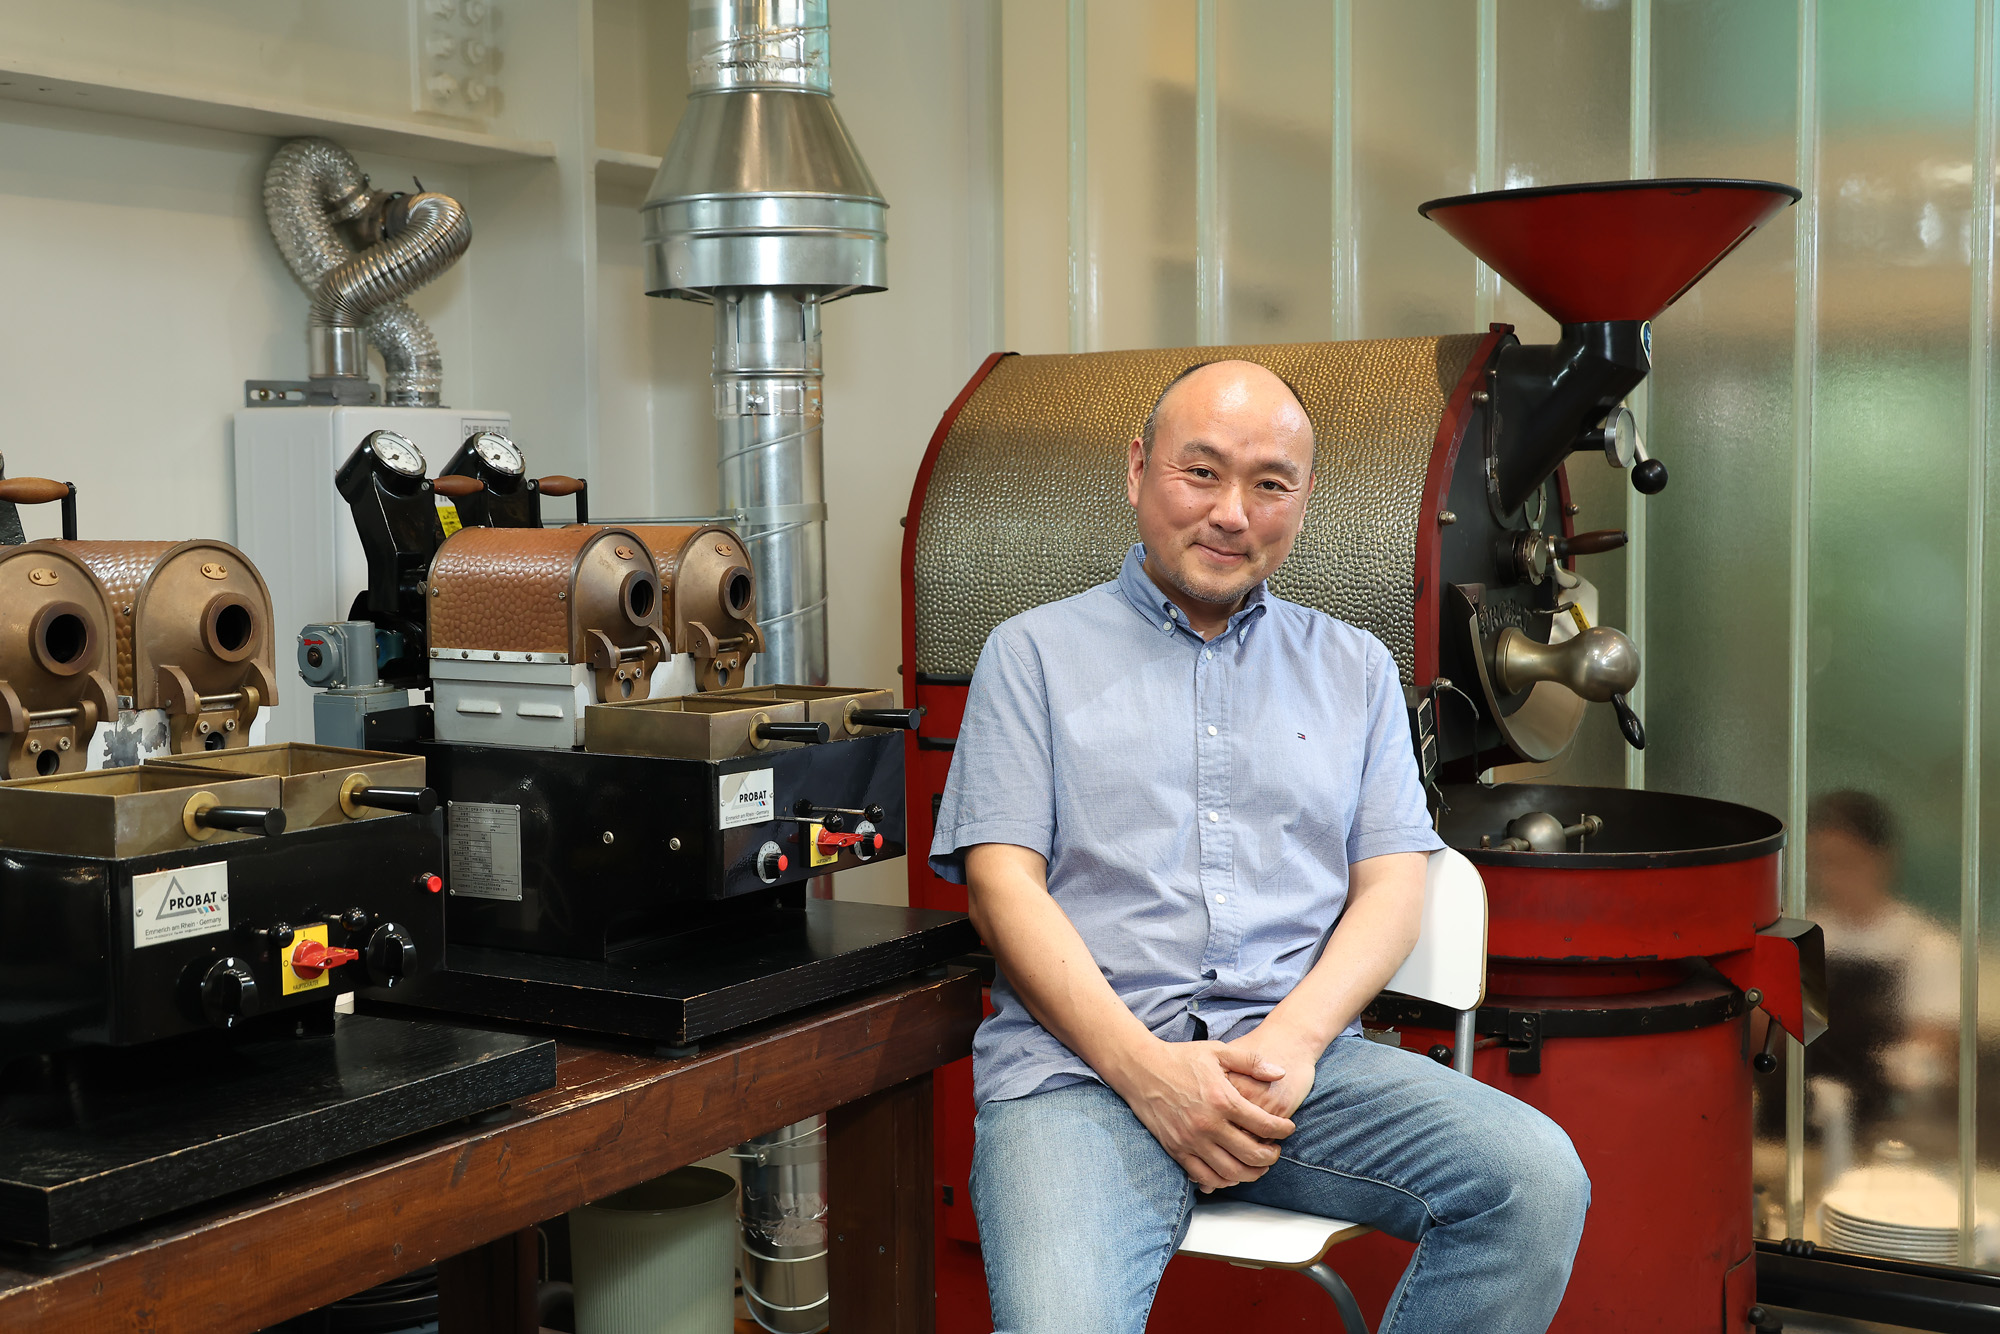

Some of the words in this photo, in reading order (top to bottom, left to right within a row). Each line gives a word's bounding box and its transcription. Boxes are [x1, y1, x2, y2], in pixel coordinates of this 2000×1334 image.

[739, 790, 767, 803] PROBAT
[170, 891, 217, 910] PROBAT
[145, 926, 170, 936] Emmerich
[180, 921, 195, 929] Rhein
[199, 917, 221, 925] Germany
[293, 980, 319, 990] HAUPTSCHALTER
